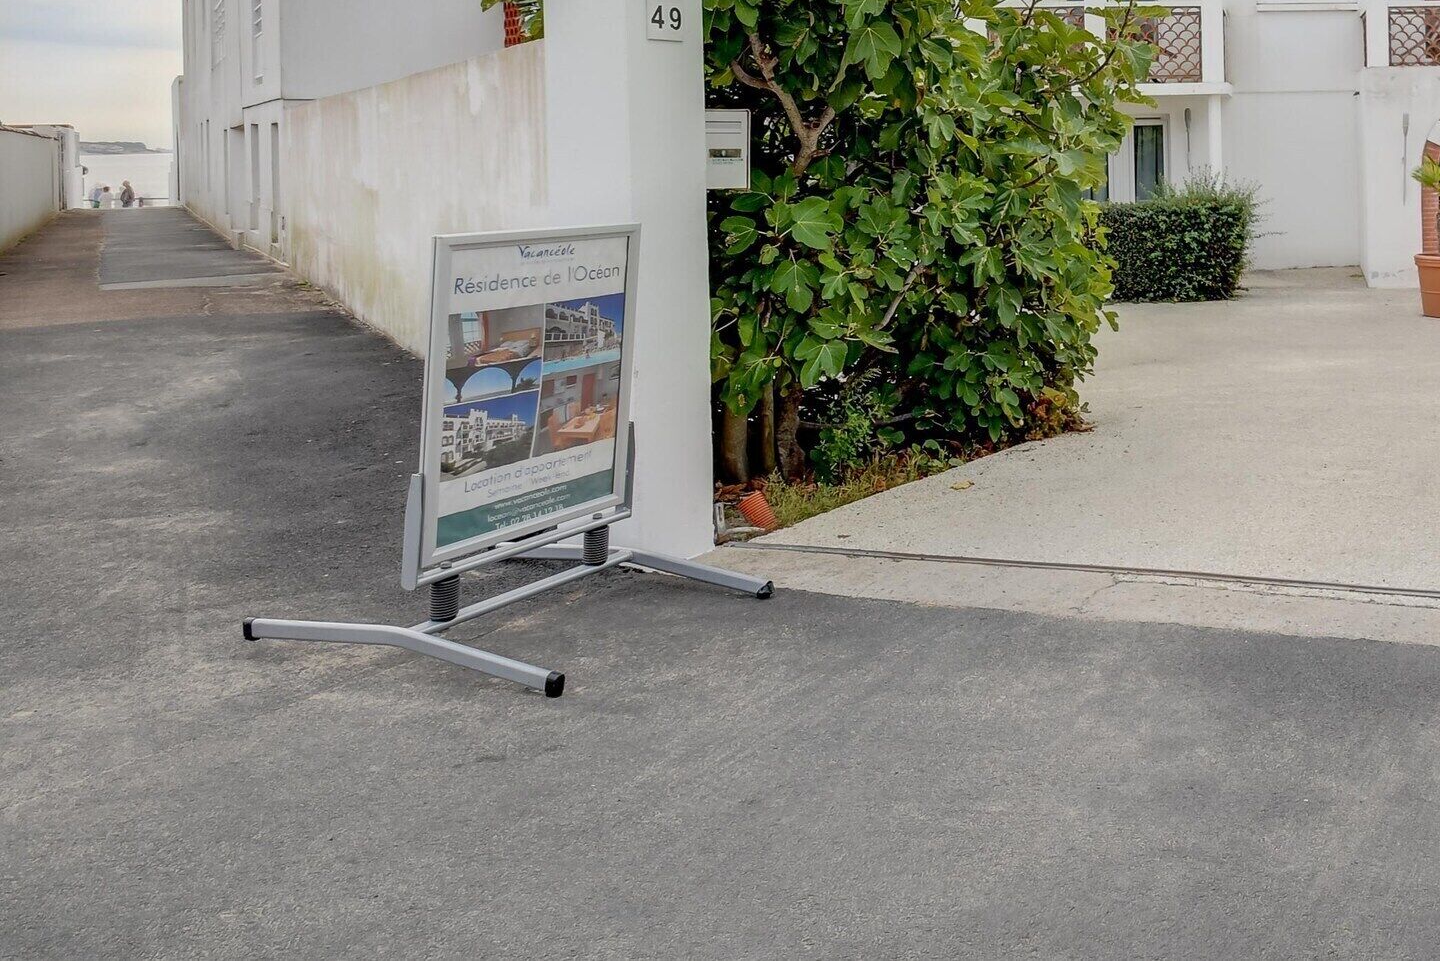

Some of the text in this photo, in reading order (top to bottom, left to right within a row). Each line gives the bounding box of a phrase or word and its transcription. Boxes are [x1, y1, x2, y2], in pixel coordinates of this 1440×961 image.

[651, 5, 682, 31] 49
[518, 243, 576, 259] Vacancéole
[454, 262, 620, 295] Résidence de l'Océan
[464, 472, 511, 494] Location
